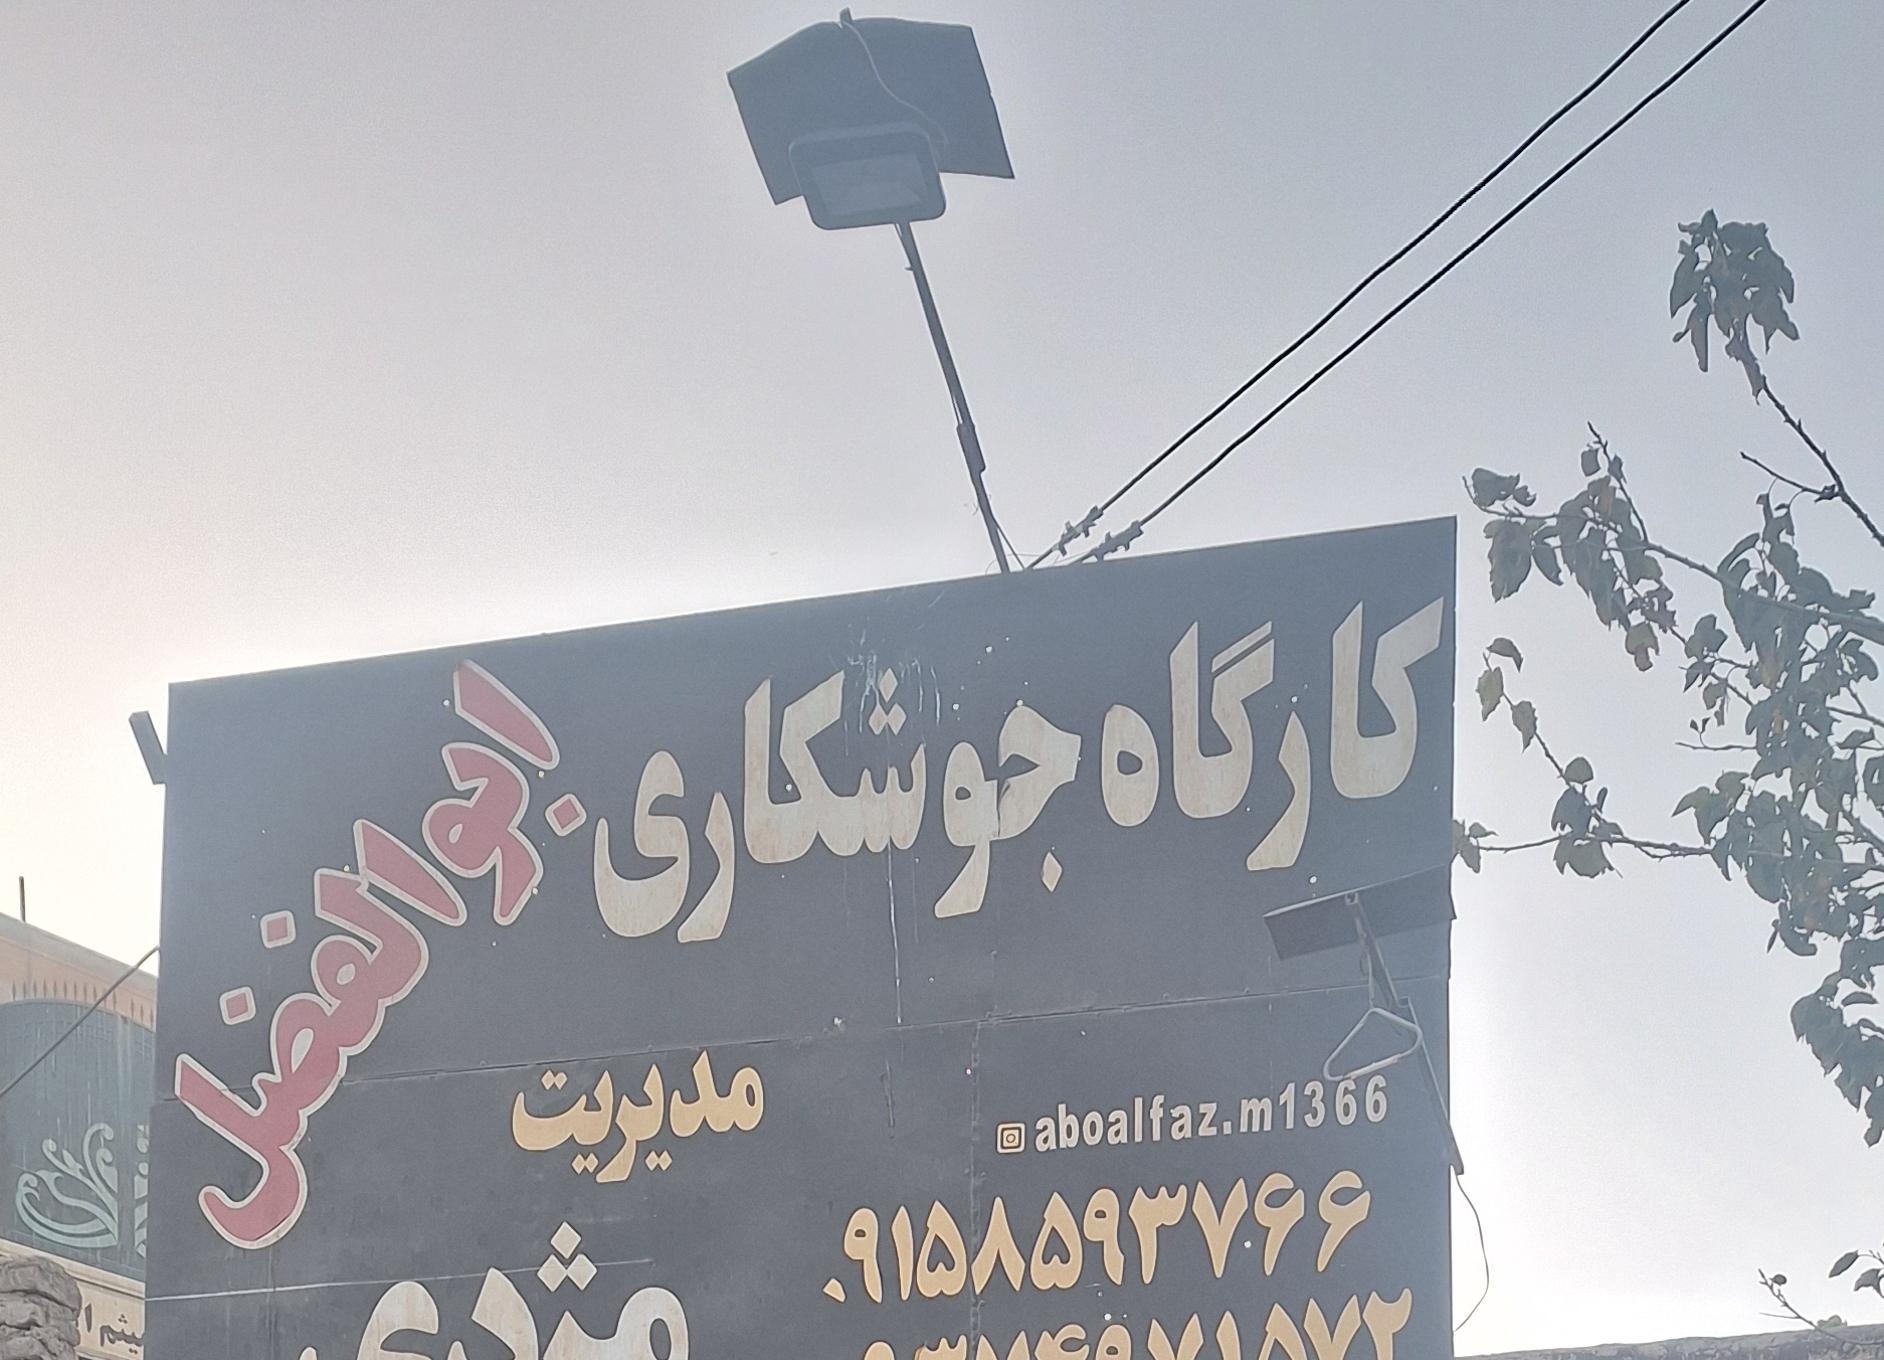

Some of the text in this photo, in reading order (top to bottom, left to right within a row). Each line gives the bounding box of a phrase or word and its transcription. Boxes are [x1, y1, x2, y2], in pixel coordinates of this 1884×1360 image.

[593, 595, 1444, 944] کارگاه جوشکاری
[174, 658, 587, 1249] ابوالفضل
[511, 1050, 765, 1183] مدیریت
[1033, 1073, 1388, 1153] aboalfaz.m1366
[822, 1170, 1371, 1303] ۰۹۱۵۸۵۹۳۷۶۶
